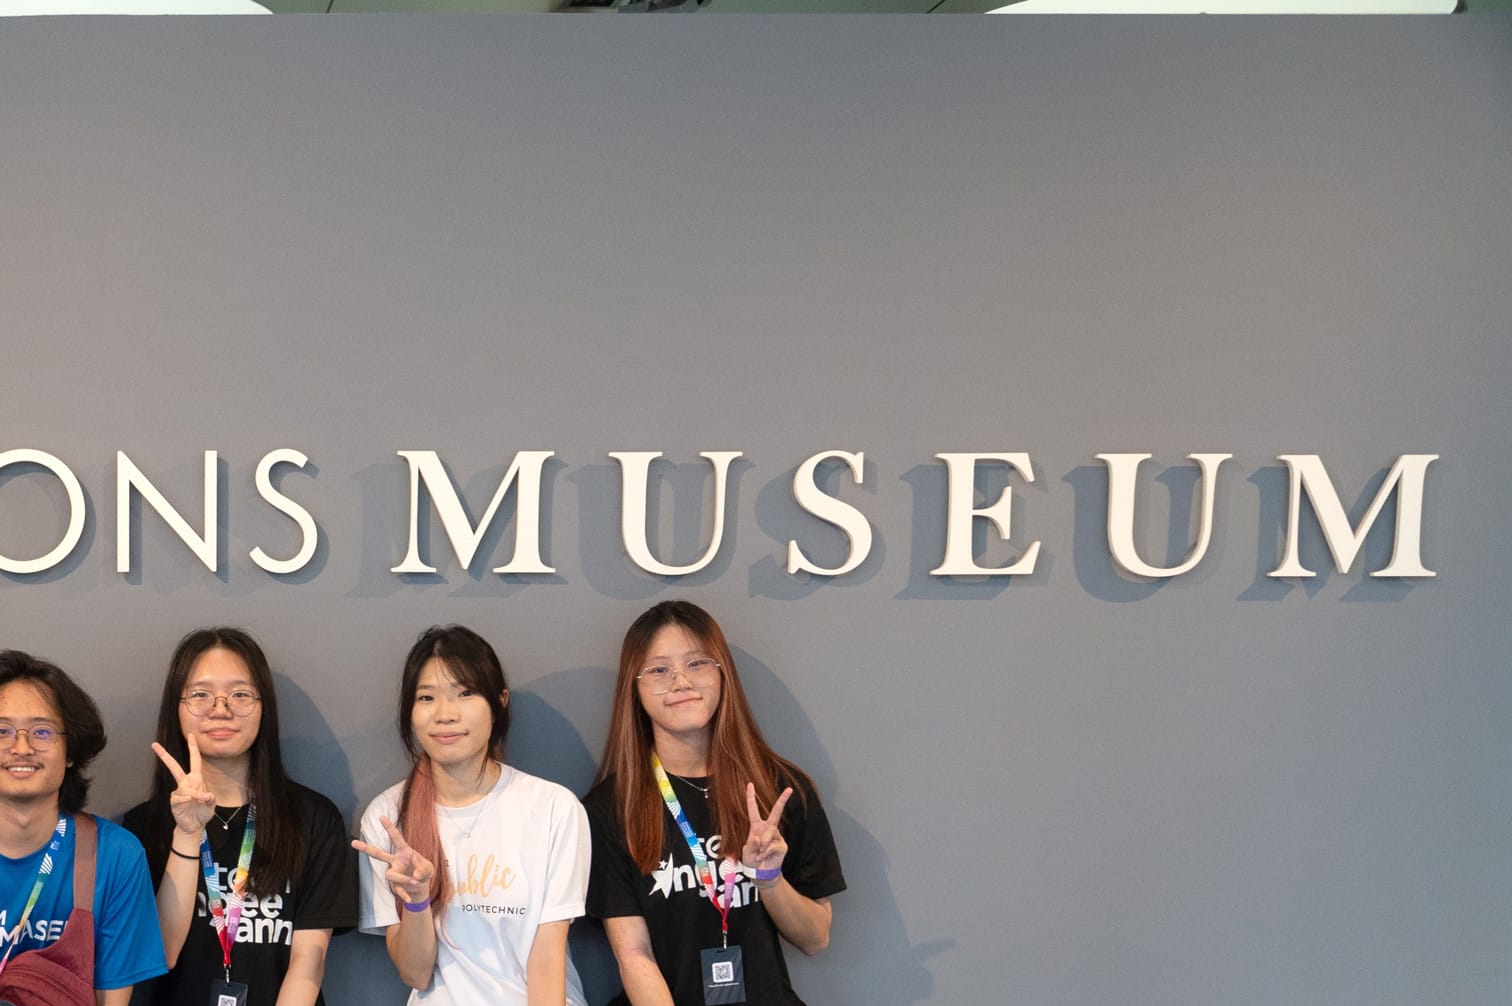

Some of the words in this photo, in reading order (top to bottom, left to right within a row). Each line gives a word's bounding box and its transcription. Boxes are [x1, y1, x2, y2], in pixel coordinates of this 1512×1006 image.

[390, 449, 1440, 580] MUSEUM
[461, 904, 526, 915] POLYTECHNIC
[234, 916, 293, 946] ann
